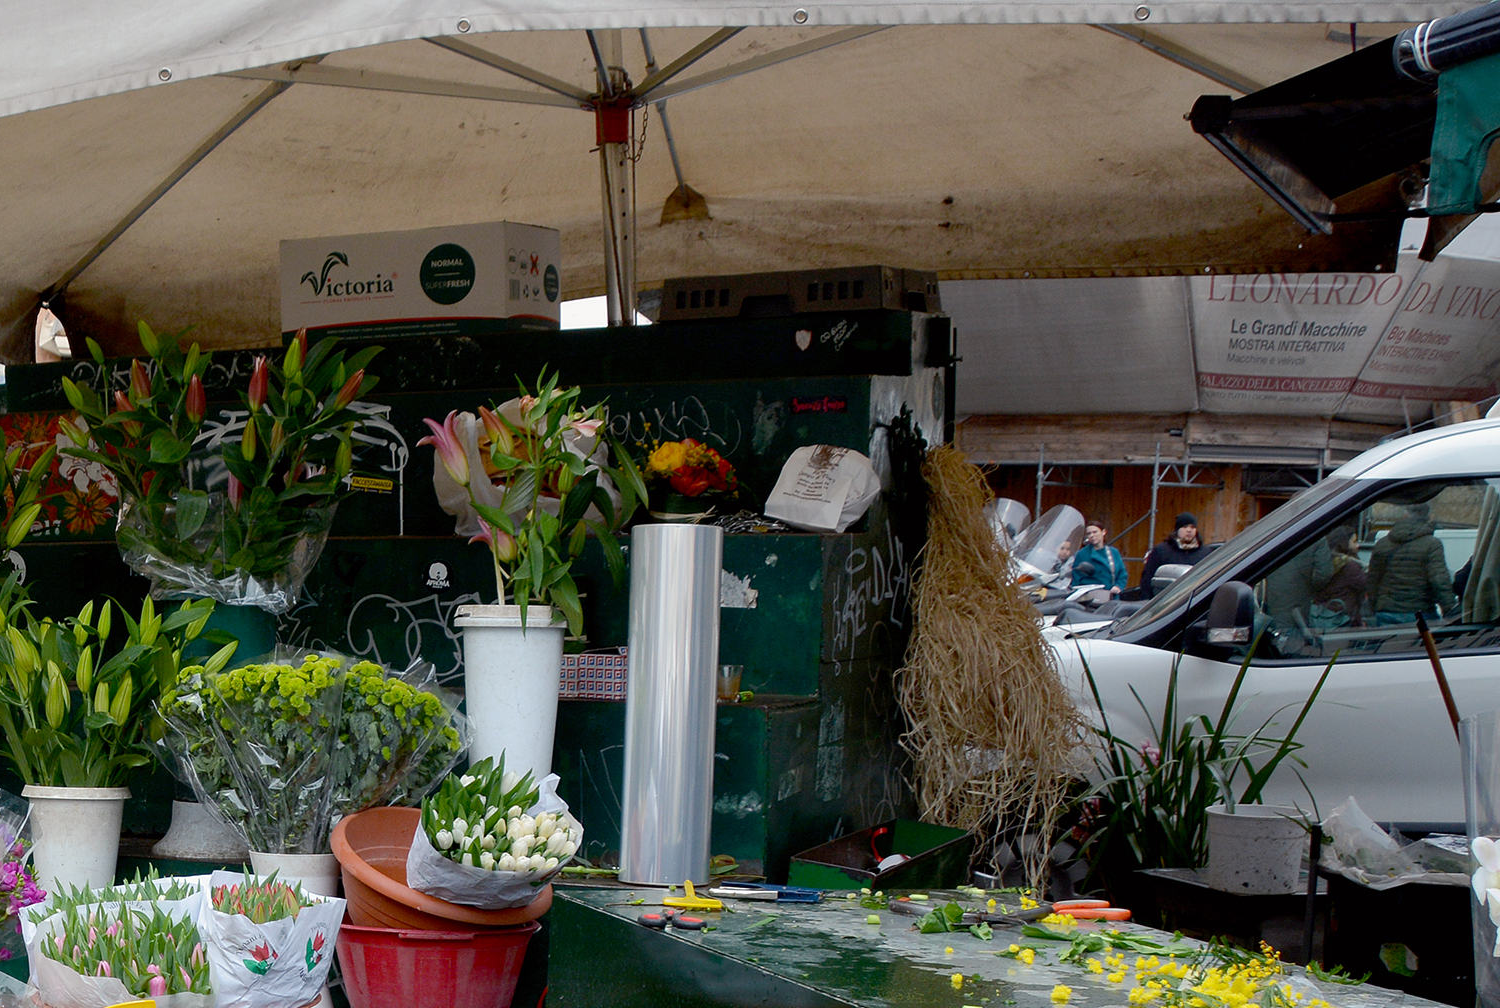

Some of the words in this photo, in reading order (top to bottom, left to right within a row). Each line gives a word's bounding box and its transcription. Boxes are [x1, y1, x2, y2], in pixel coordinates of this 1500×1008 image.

[431, 258, 464, 268] NORMAL
[299, 251, 394, 297] Victoria
[425, 279, 471, 290] SUPERFRESH
[1207, 273, 1403, 306] LEONARDO
[1404, 281, 1444, 314] DA
[1231, 318, 1248, 335] Le
[1251, 319, 1298, 337] Grandi
[1300, 321, 1367, 338] Macchine
[1387, 326, 1406, 344] Big
[1406, 327, 1452, 346] Machines
[1228, 338, 1275, 352] MOSTRA
[1277, 340, 1346, 353] INTERATTIVA
[1377, 344, 1428, 361] INTERACTIVE
[1226, 353, 1268, 365] Macchine
[1200, 374, 1245, 389] PALAZZO
[1246, 377, 1280, 390] DELLA
[1280, 378, 1351, 392] CANCELLERIA
[1353, 383, 1382, 395] ROMA
